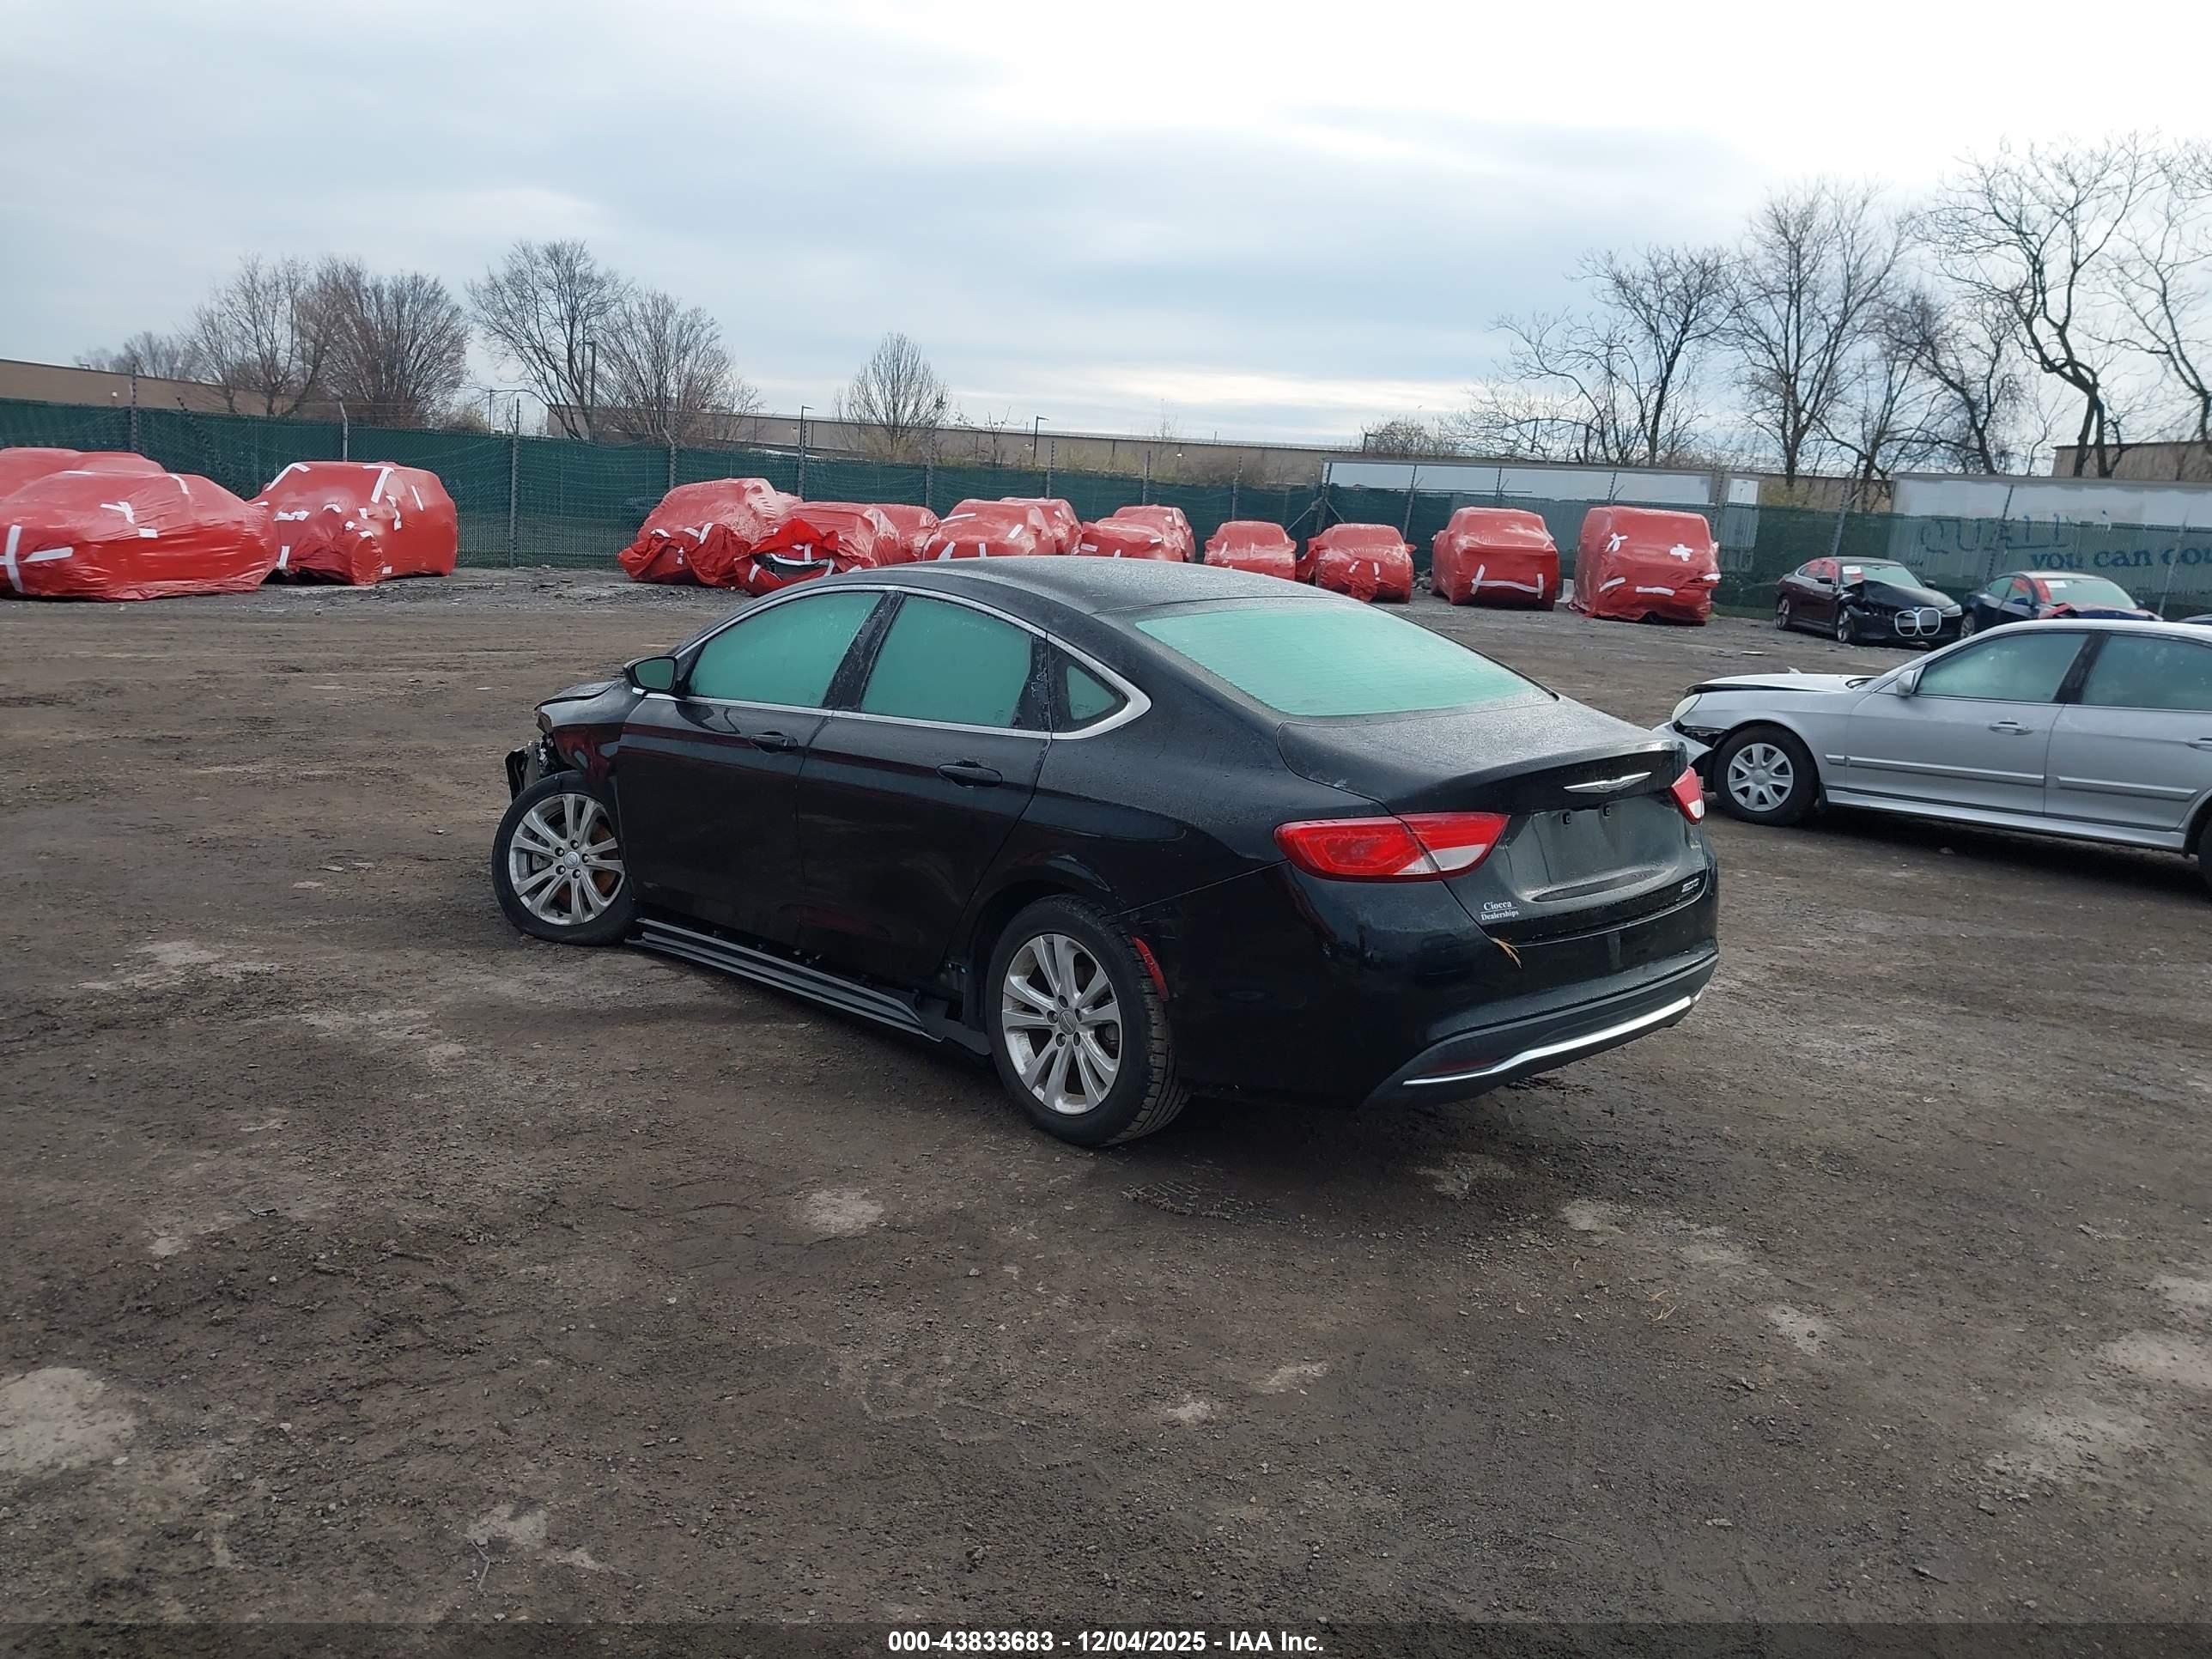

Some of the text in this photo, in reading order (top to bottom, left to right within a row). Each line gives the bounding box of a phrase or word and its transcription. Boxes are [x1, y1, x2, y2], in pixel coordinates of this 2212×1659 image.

[2029, 551, 2084, 570] you
[2094, 550, 2153, 568] can
[1483, 901, 1513, 911] Ciocca
[1480, 910, 1519, 921] Dealerships
